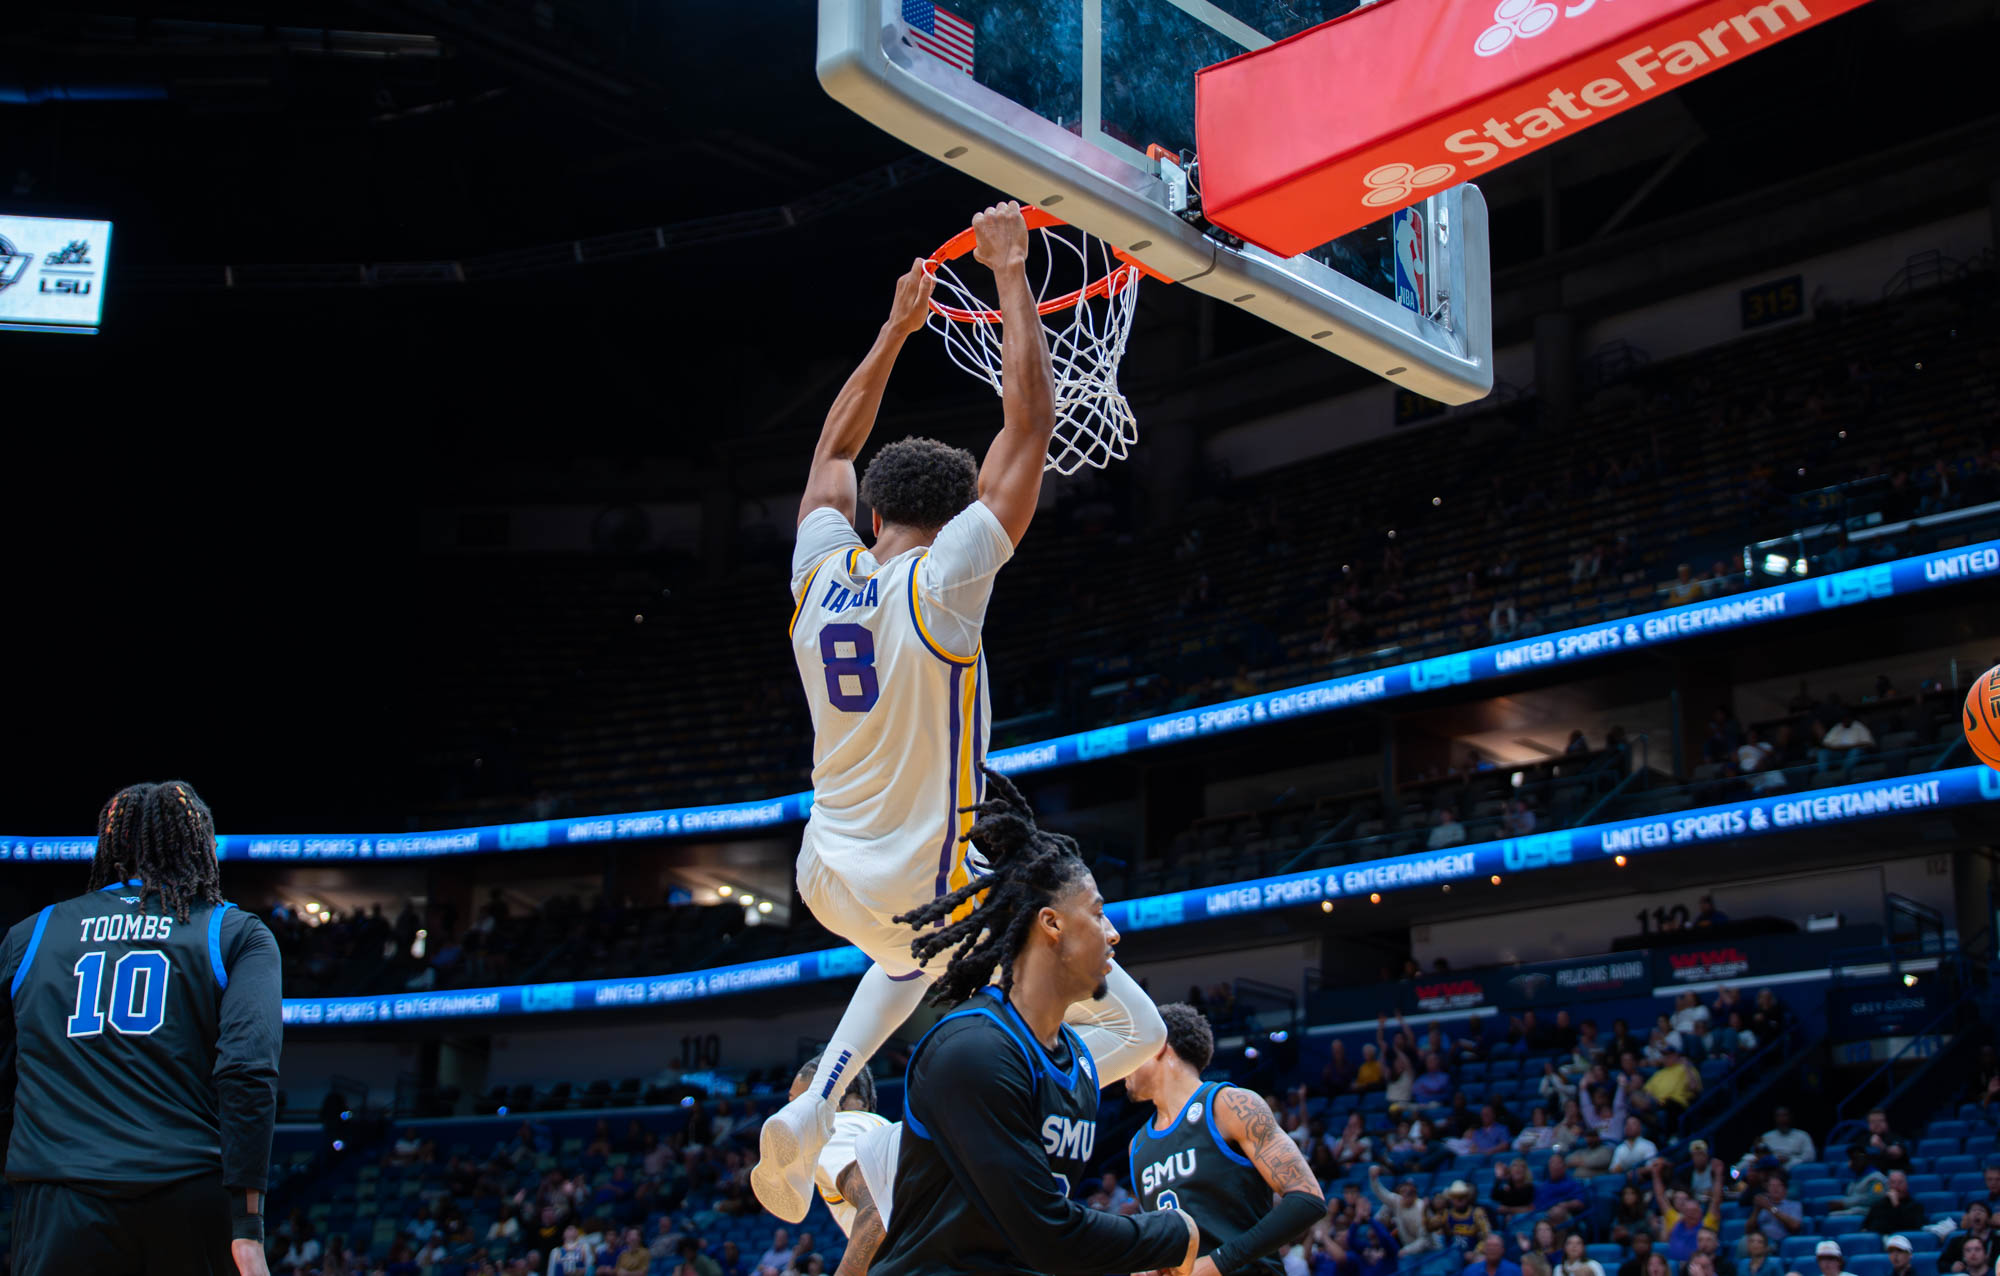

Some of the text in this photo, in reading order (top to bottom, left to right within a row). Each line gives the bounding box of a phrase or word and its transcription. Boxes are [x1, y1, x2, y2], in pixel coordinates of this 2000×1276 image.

[40, 278, 91, 295] LSU
[1400, 286, 1415, 310] NBA
[1925, 549, 2000, 582] UNITED
[1817, 565, 1893, 607] USE
[1495, 592, 1785, 671] UNITED SPORTS & ENTERTAINMENT
[819, 623, 879, 712] 8
[1410, 654, 1471, 691] USE
[1148, 676, 1385, 742] UNITED SPORTS & ENTERTAINMENT
[1077, 726, 1128, 760] USE
[568, 820, 614, 842] UNITED
[616, 815, 664, 837] SPORTS
[667, 814, 680, 834] &
[682, 802, 783, 832] ENTERTAINMENT
[1602, 780, 1940, 852] UNITED SPORTS & ENTERTAINMENT
[13, 842, 27, 859] &
[248, 839, 300, 858] UNITED
[302, 838, 356, 858] SPORTS
[359, 838, 373, 858] &
[376, 832, 479, 858] ENTERTAINMENT
[1503, 832, 1573, 871] USE
[1206, 852, 1474, 914] UNITED SPORTS & ENTERTAINMENT
[80, 914, 173, 941] TOOMBS
[1126, 894, 1184, 930] USE
[67, 950, 170, 1038] 10
[596, 961, 800, 1006] UNITED SPORTS & ENTERTAINMENT
[282, 993, 499, 1023] NITED SPORTS & ENTERTAINMENT
[1041, 1114, 1096, 1162] SMU
[1141, 1148, 1197, 1196] SMU
